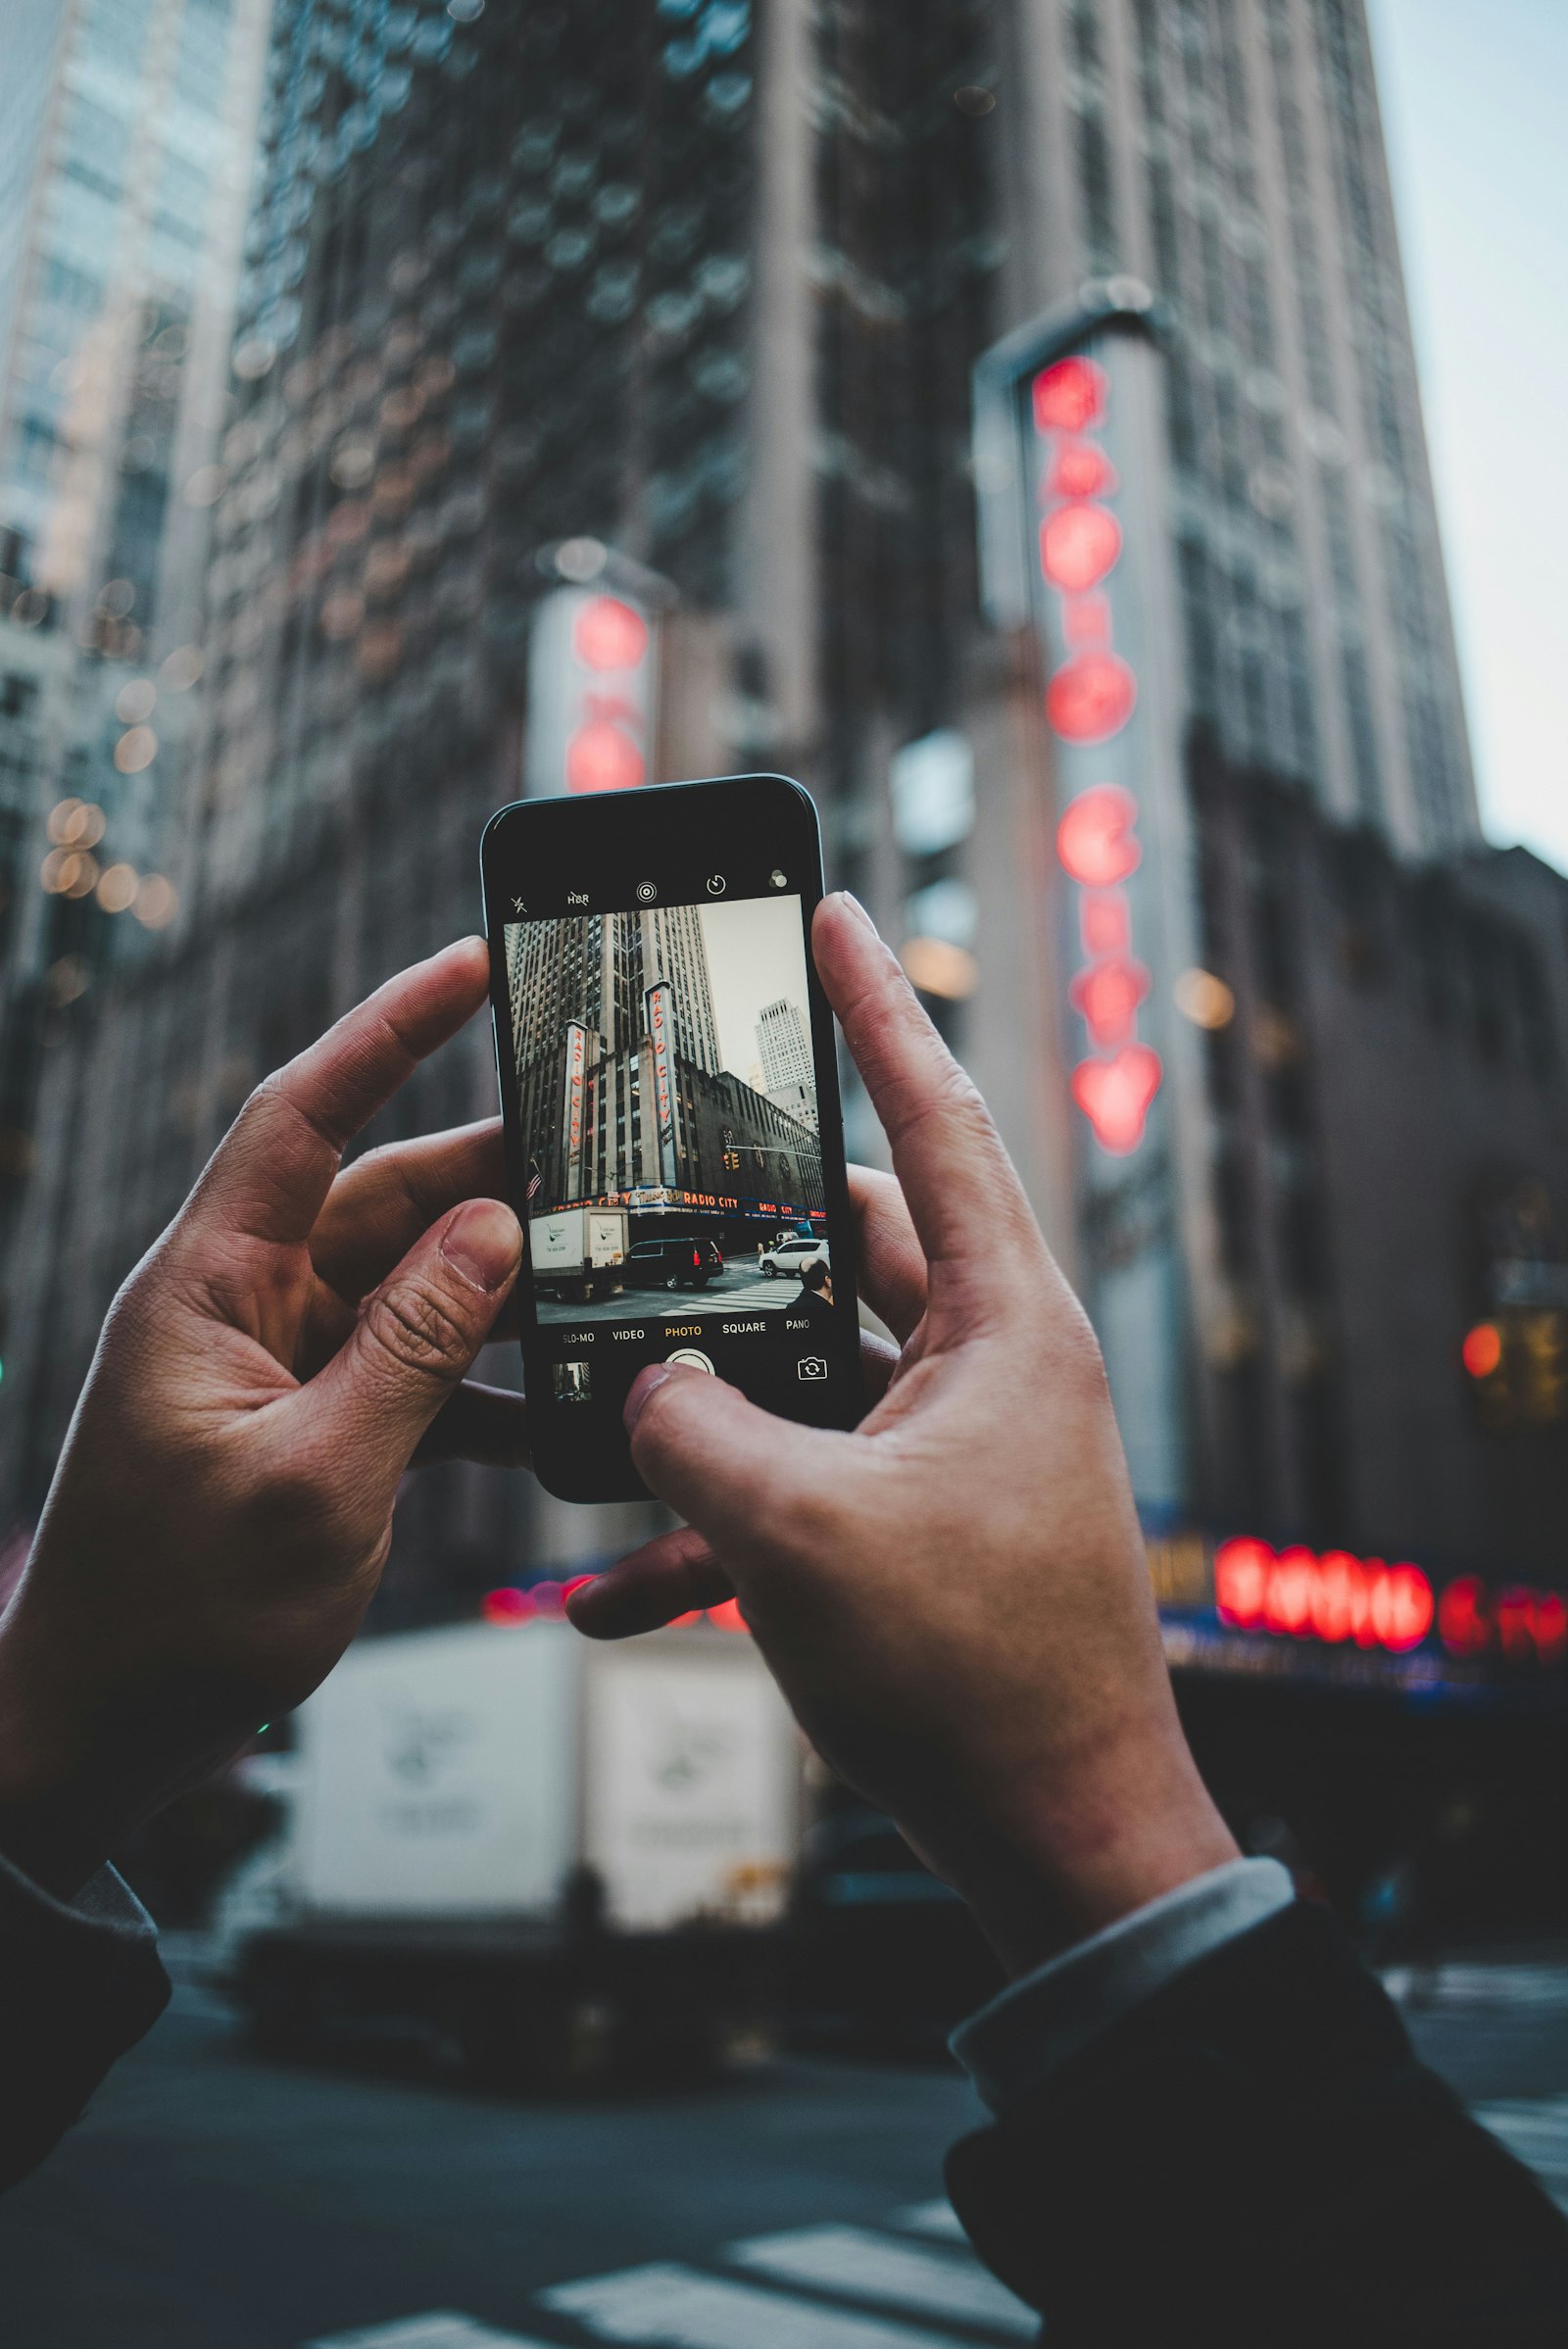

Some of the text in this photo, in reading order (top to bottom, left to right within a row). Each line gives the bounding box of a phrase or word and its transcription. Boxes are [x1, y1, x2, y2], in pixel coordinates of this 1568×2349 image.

[567, 894, 590, 905] HDR
[653, 992, 666, 1055] RADIO
[658, 1064, 670, 1124] CITY
[683, 1191, 738, 1209] RADIO CITY
[563, 1319, 810, 1344] SLO-MO VIDEO PHOTO SQUARE PANO
